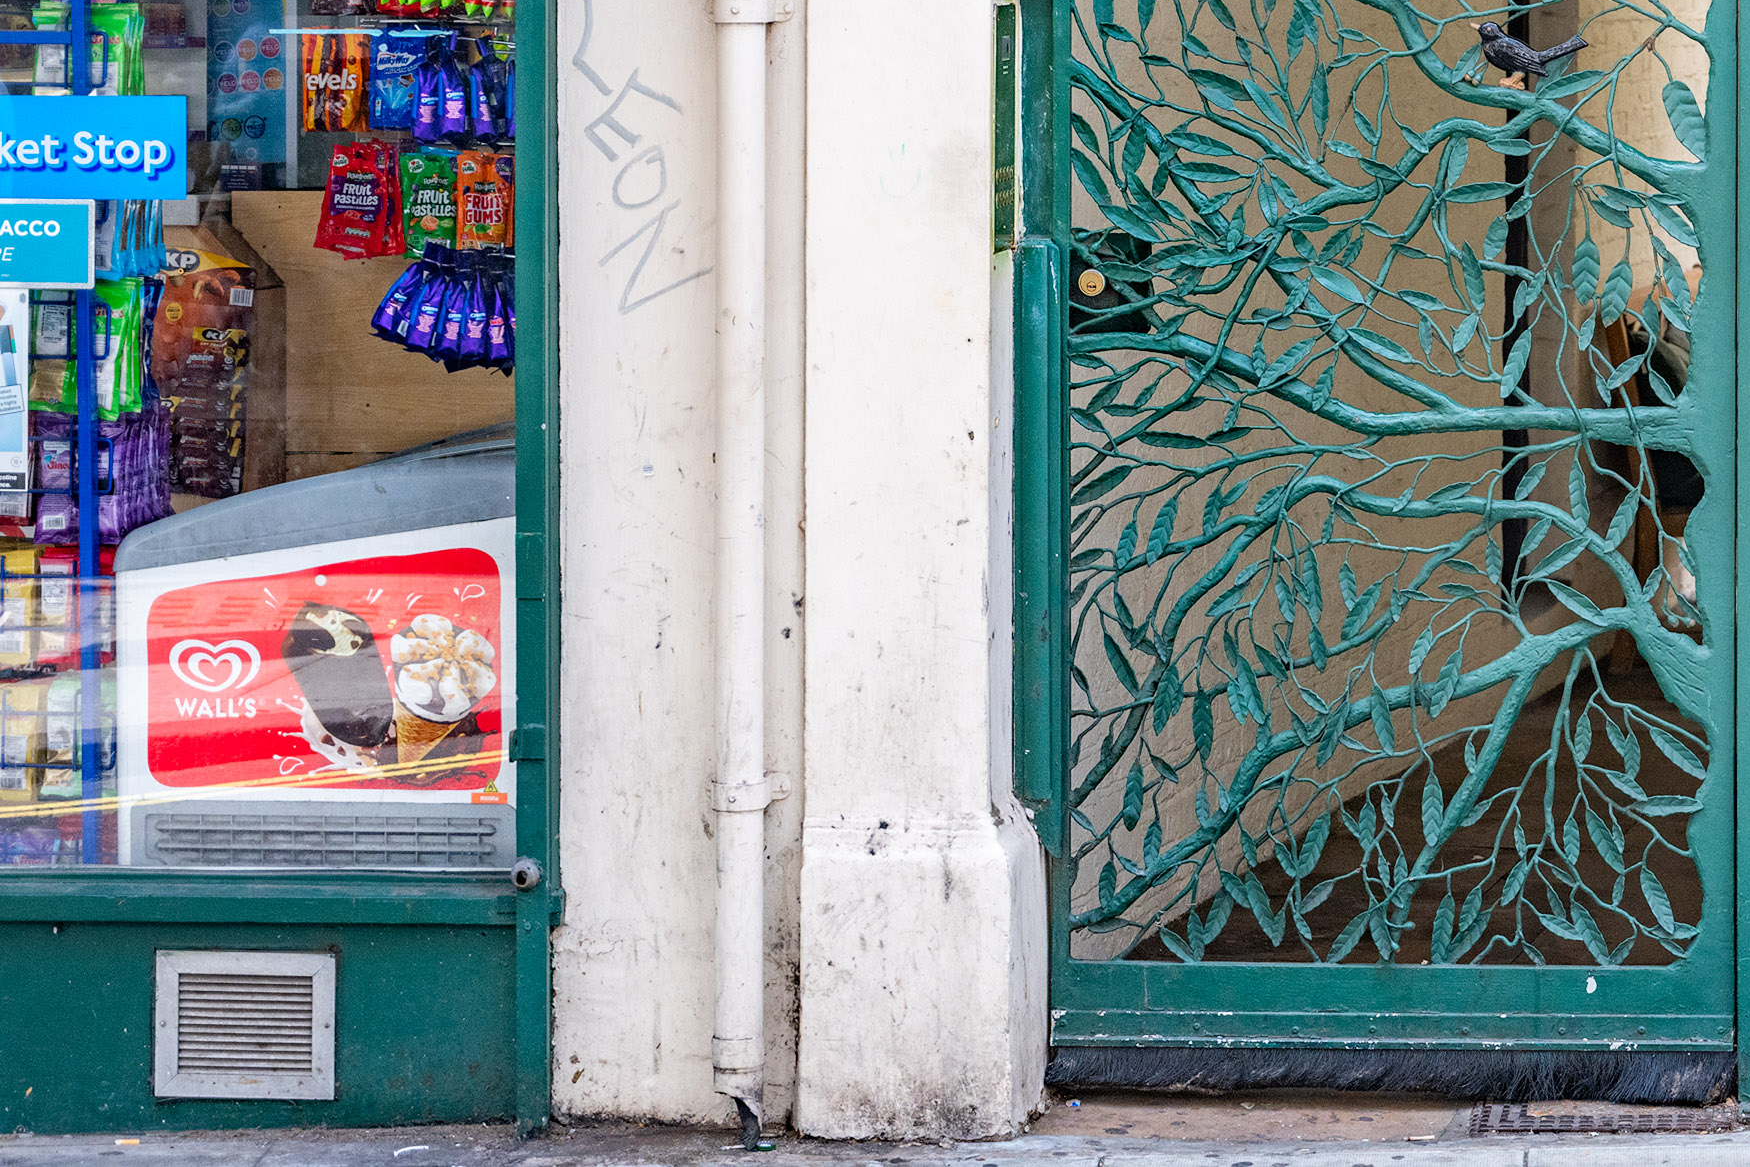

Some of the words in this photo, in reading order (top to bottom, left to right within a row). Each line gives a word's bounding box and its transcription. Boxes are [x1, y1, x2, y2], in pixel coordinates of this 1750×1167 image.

[72, 131, 168, 174] Stop
[465, 209, 503, 225] GUMS
[174, 697, 257, 718] WALL'S
